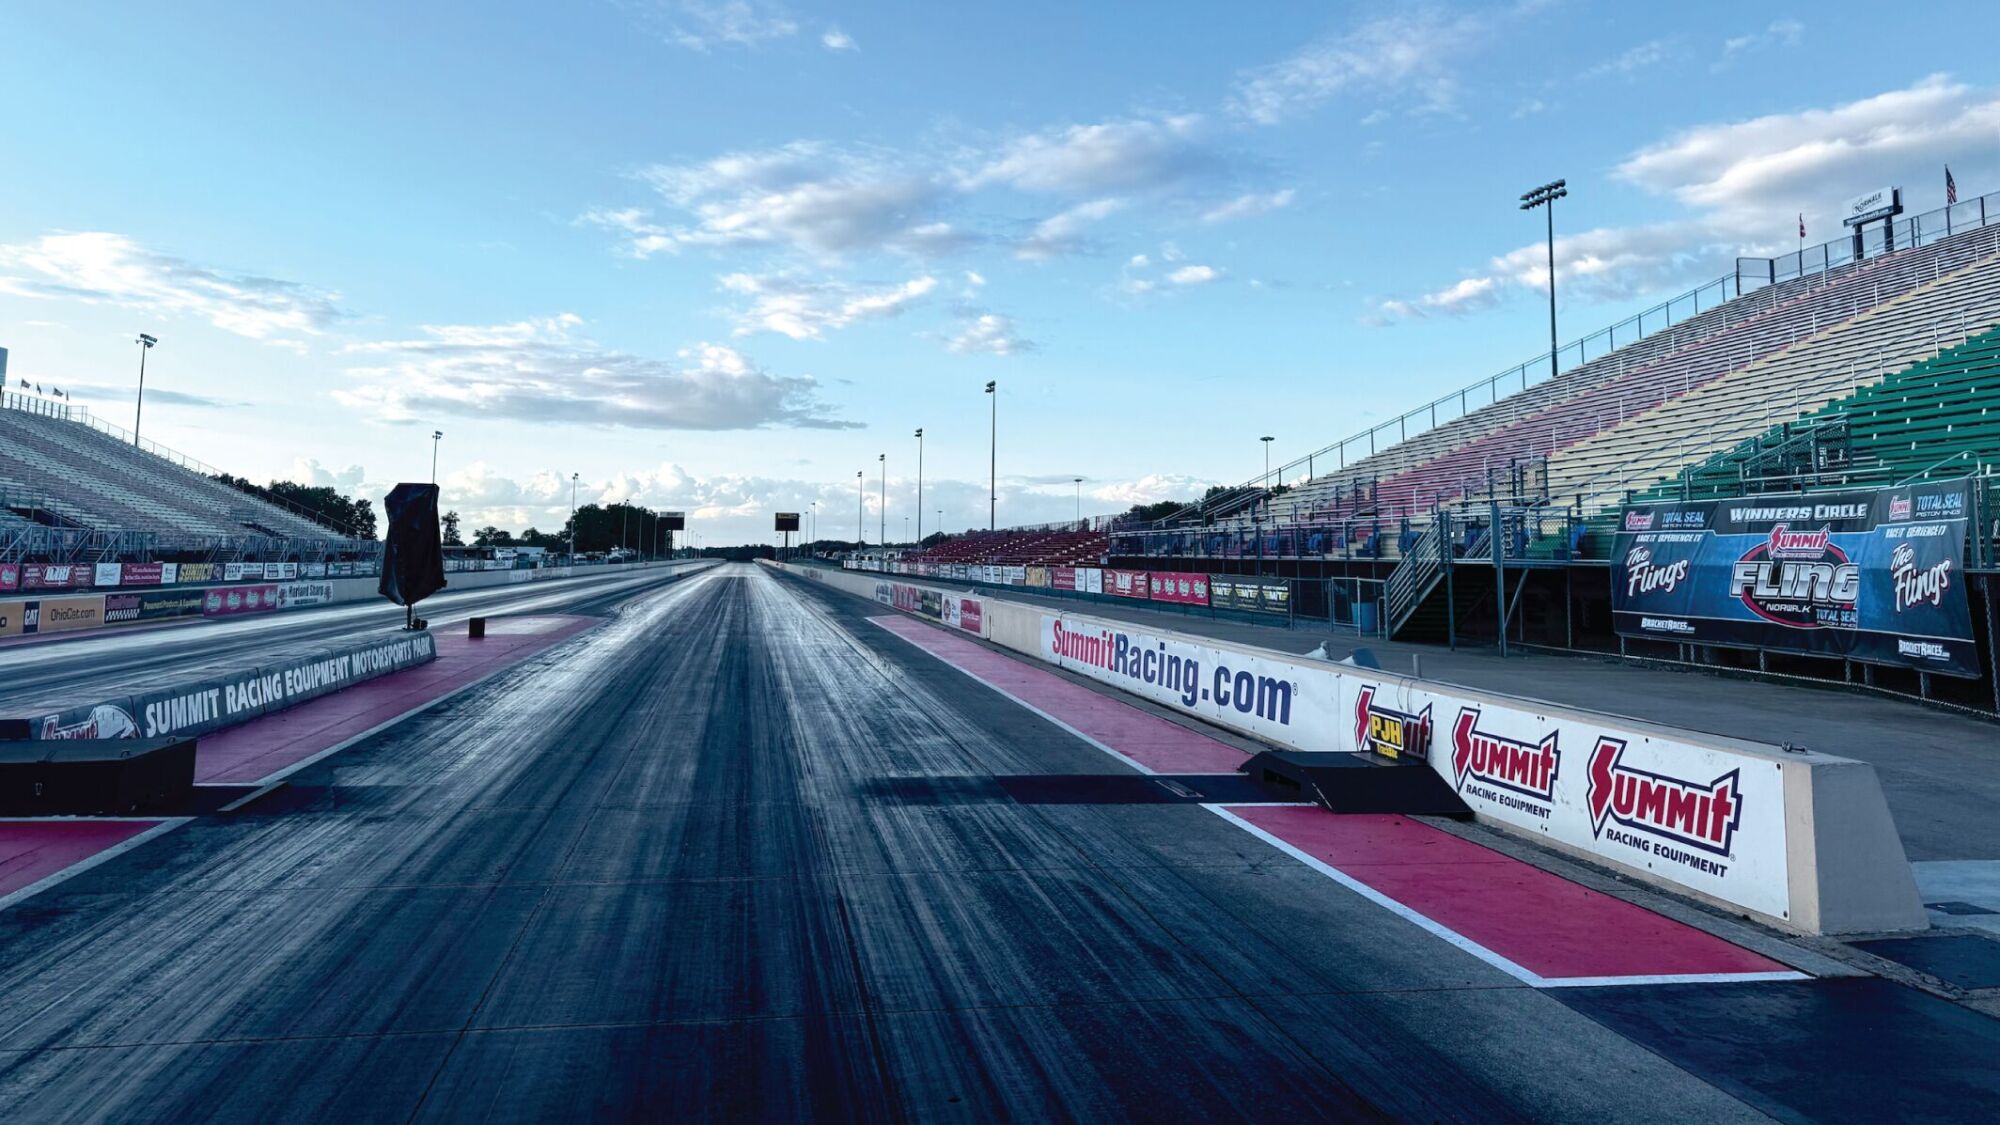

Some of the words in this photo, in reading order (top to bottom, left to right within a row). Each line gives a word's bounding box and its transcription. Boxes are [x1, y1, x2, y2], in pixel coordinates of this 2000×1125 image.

[1663, 513, 1682, 524] TOTAL
[1684, 512, 1704, 523] SEAL
[1730, 507, 1812, 522] WINNERS
[1814, 503, 1867, 521] CIRCLE
[1917, 495, 1942, 511] TOTAL
[1943, 493, 1962, 509] SEAL
[1626, 546, 1650, 566] The
[1768, 523, 1830, 560] SUMMIT
[1891, 543, 1914, 571] The
[1628, 560, 1687, 596] Flings
[1730, 561, 1859, 602] FLING
[1894, 560, 1951, 612] Flings
[25, 609, 38, 626] CAT
[50, 608, 95, 621] OhioCat.com
[146, 688, 219, 738] SUMMIT
[226, 677, 282, 714] RACING
[286, 655, 349, 697] EQUIPMENT
[352, 640, 411, 676] MOTORSPORTS
[413, 636, 431, 657] PARK
[1053, 619, 1291, 726] SummitRacing.com
[1354, 685, 1433, 760] SMIT
[1370, 715, 1402, 747] PJH
[1451, 706, 1560, 801] SUMMIT
[1466, 783, 1498, 803] RACING
[1499, 794, 1551, 820] EQUIPMENT
[1586, 735, 1743, 857] SUMMIT
[1606, 827, 1650, 853] RACING
[1653, 842, 1729, 878] EQUIPMENT
